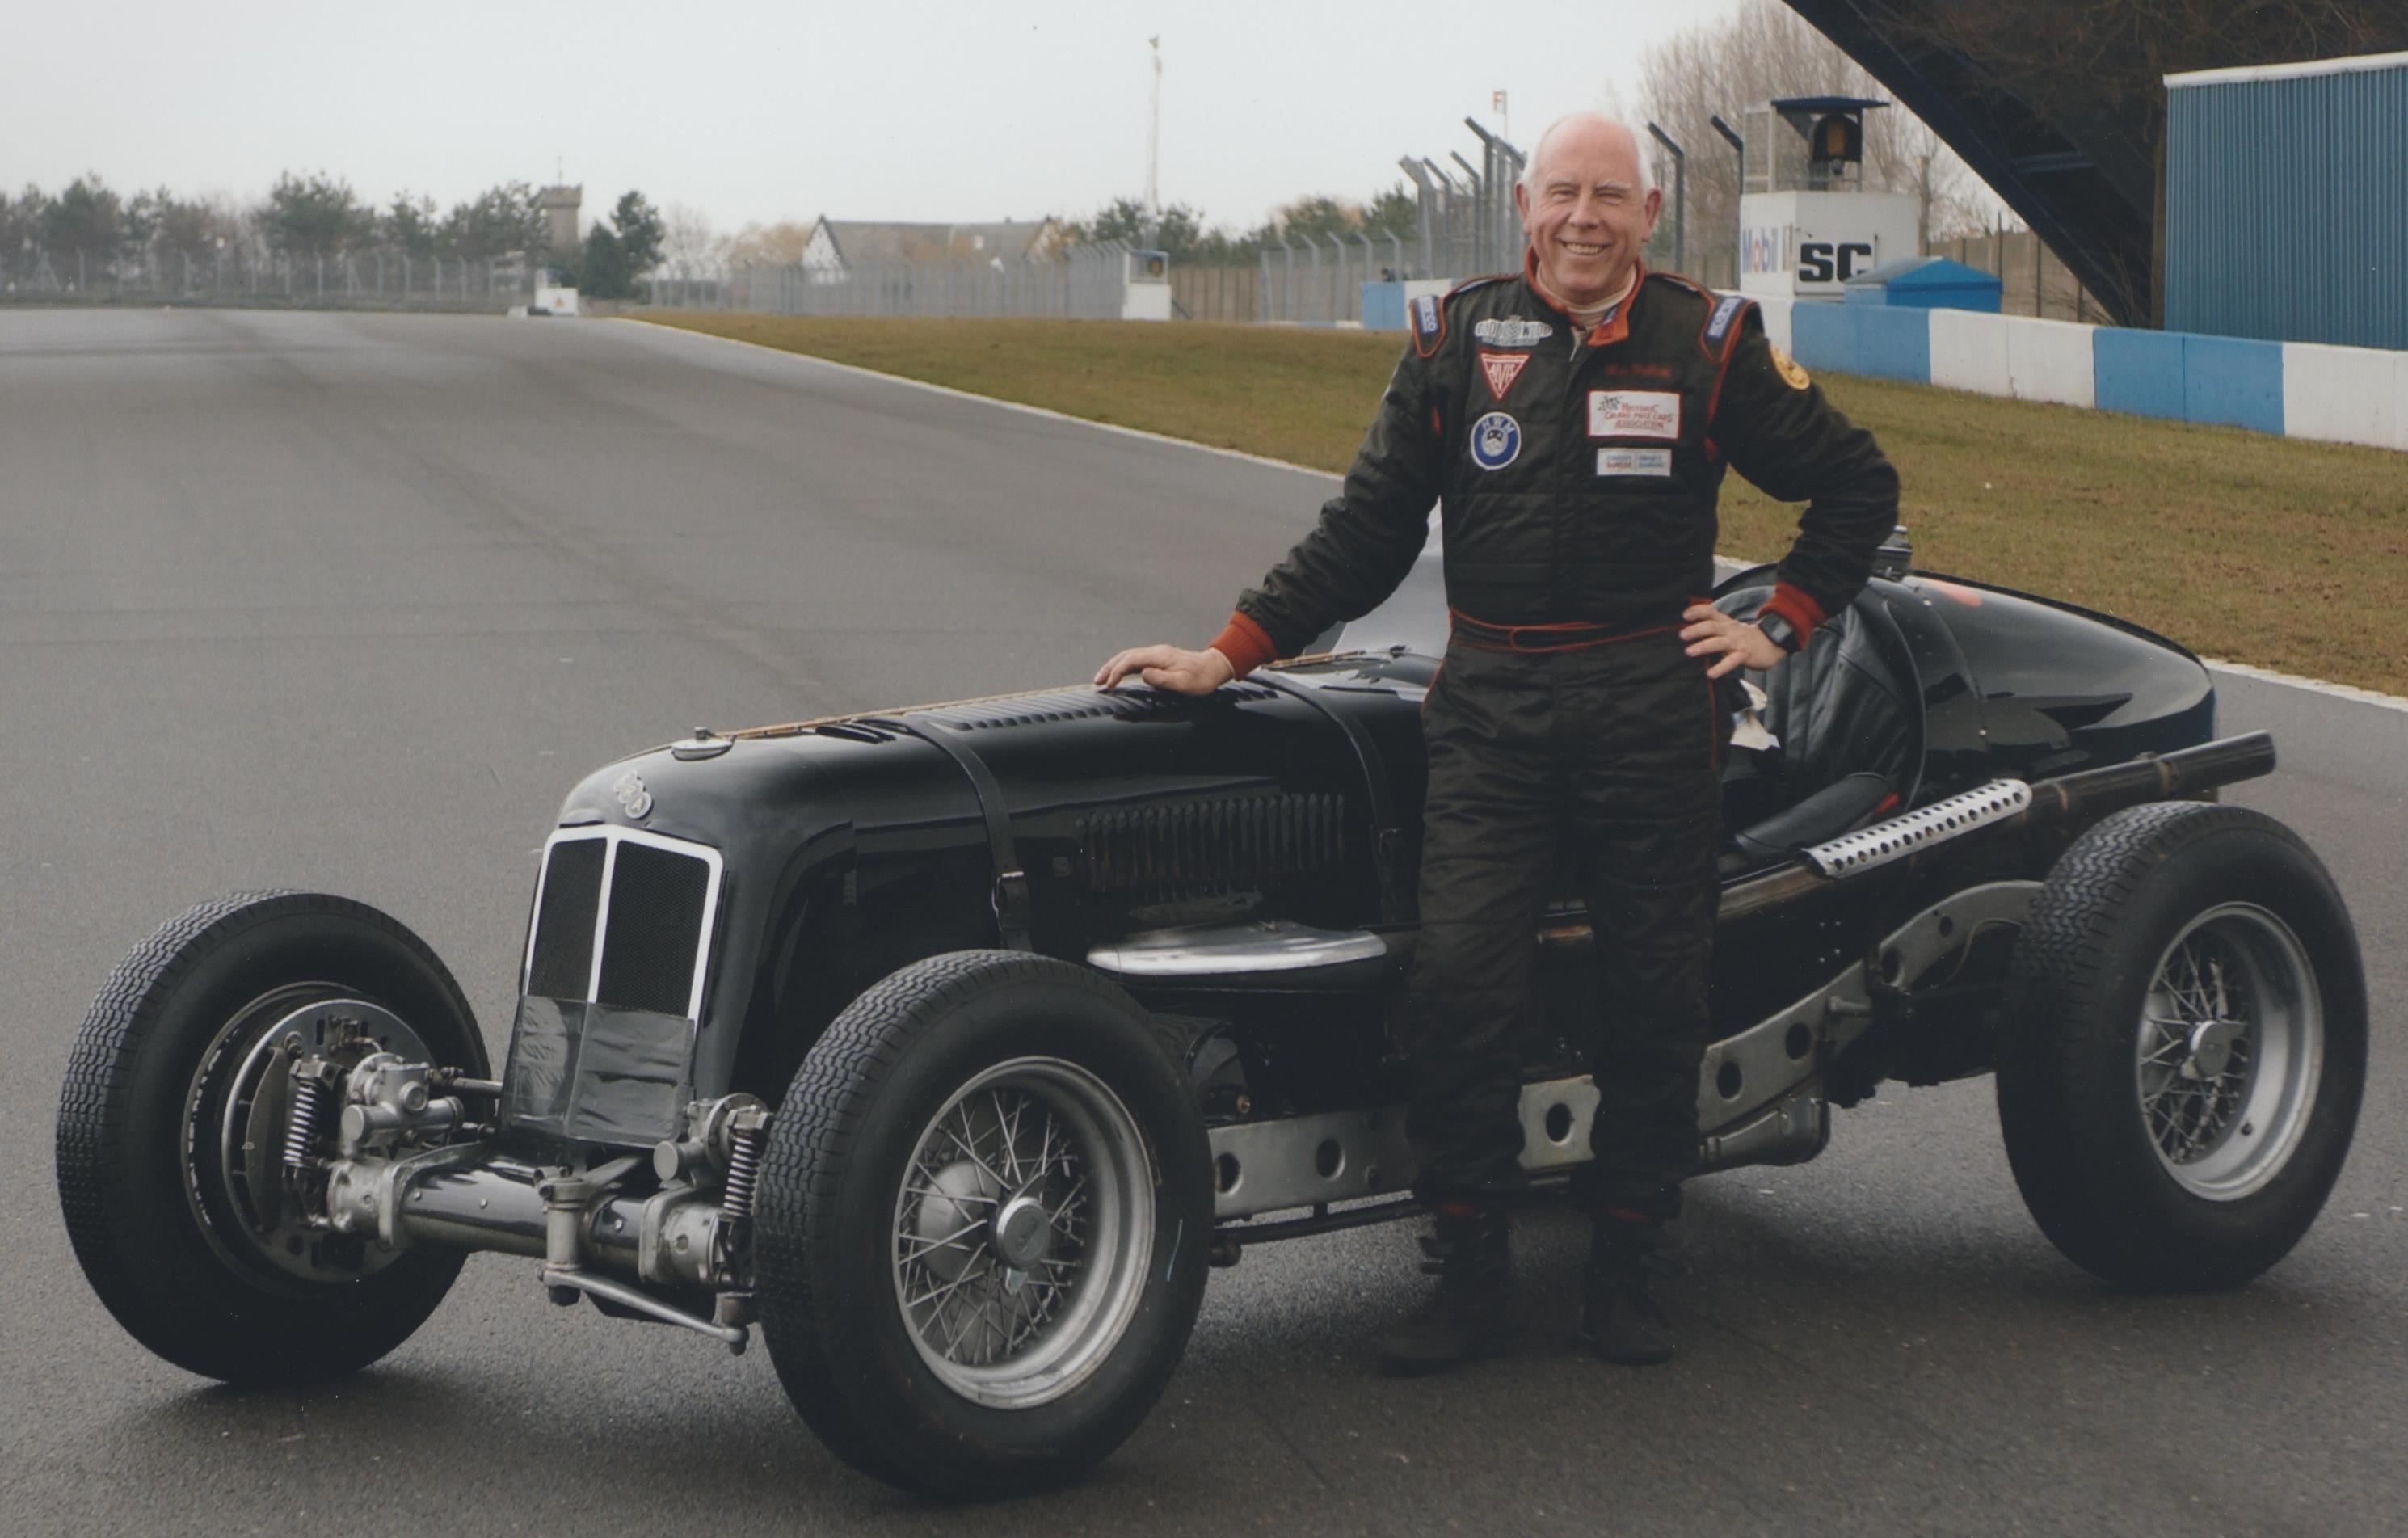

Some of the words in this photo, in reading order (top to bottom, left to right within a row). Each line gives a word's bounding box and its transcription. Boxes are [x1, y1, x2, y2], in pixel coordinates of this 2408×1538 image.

[1742, 227, 1778, 273] Mobil
[1488, 362, 1516, 390] ALVIS
[1481, 415, 1515, 434] HWM
